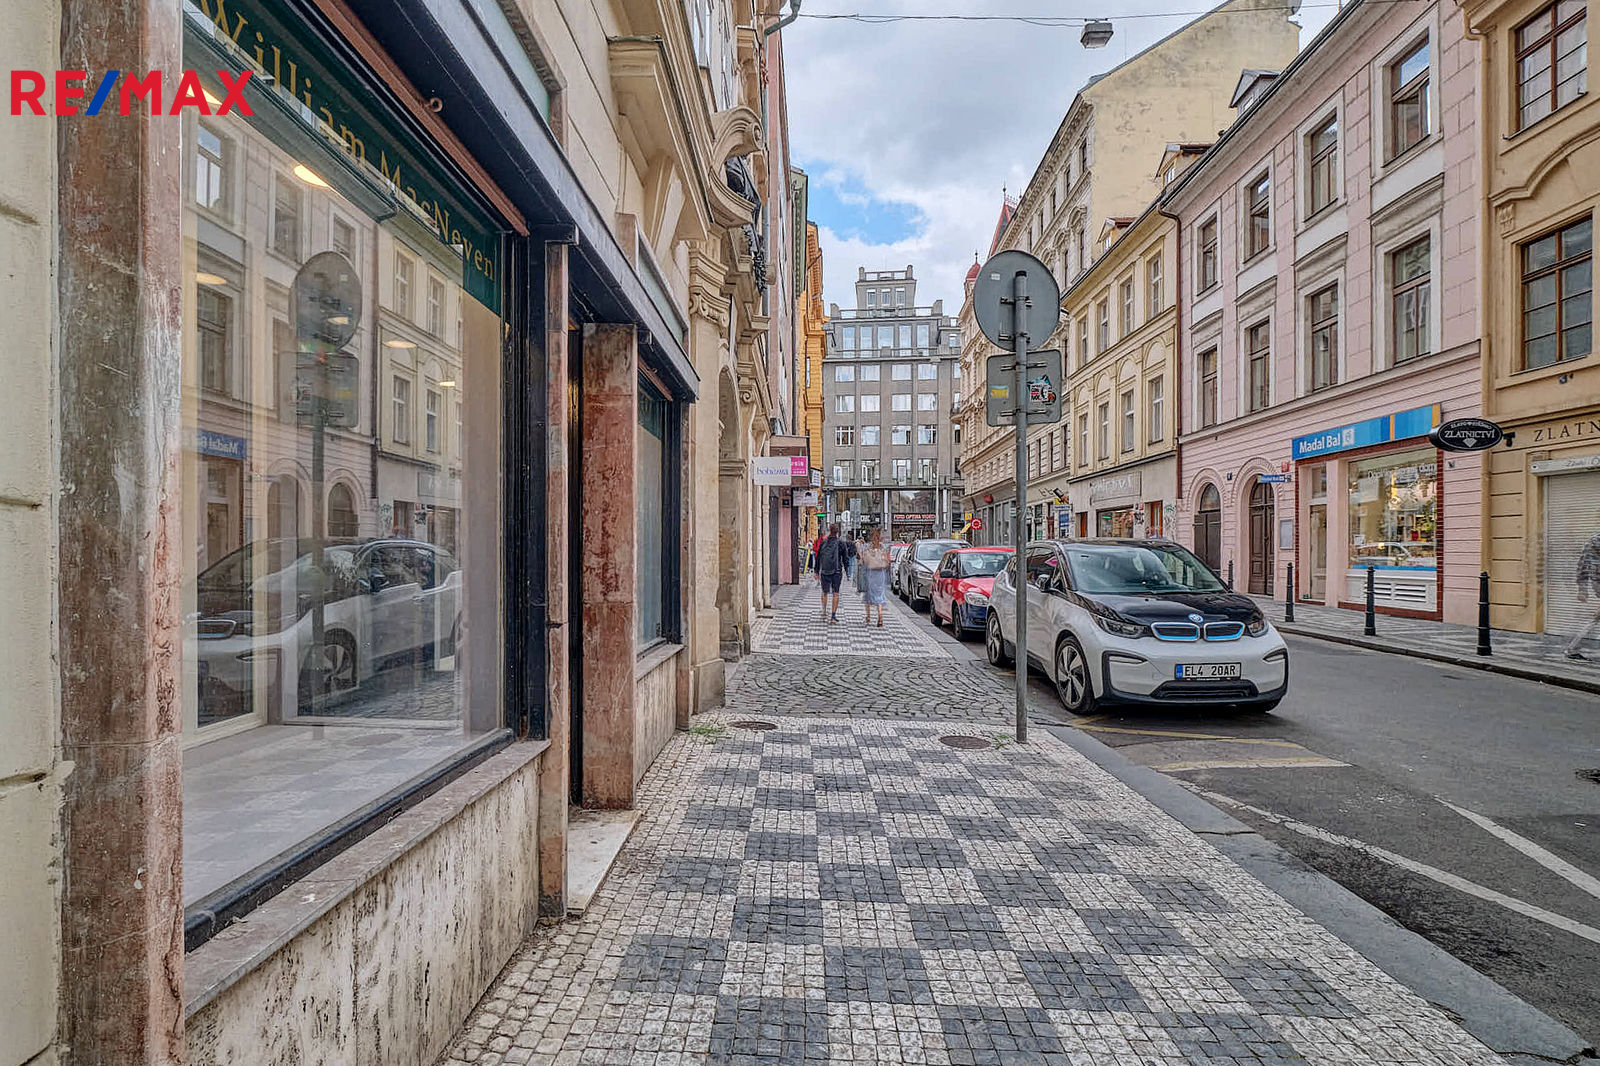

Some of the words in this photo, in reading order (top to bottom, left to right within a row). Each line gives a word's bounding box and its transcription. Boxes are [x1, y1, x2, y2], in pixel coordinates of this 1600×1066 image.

[379, 149, 496, 282] MacNeven
[1444, 429, 1496, 439] ZLATNICTVÍ
[1299, 436, 1325, 454] Madal
[1326, 432, 1341, 448] Bal
[1184, 665, 1204, 677] EL4
[1211, 665, 1236, 676] 20AR
